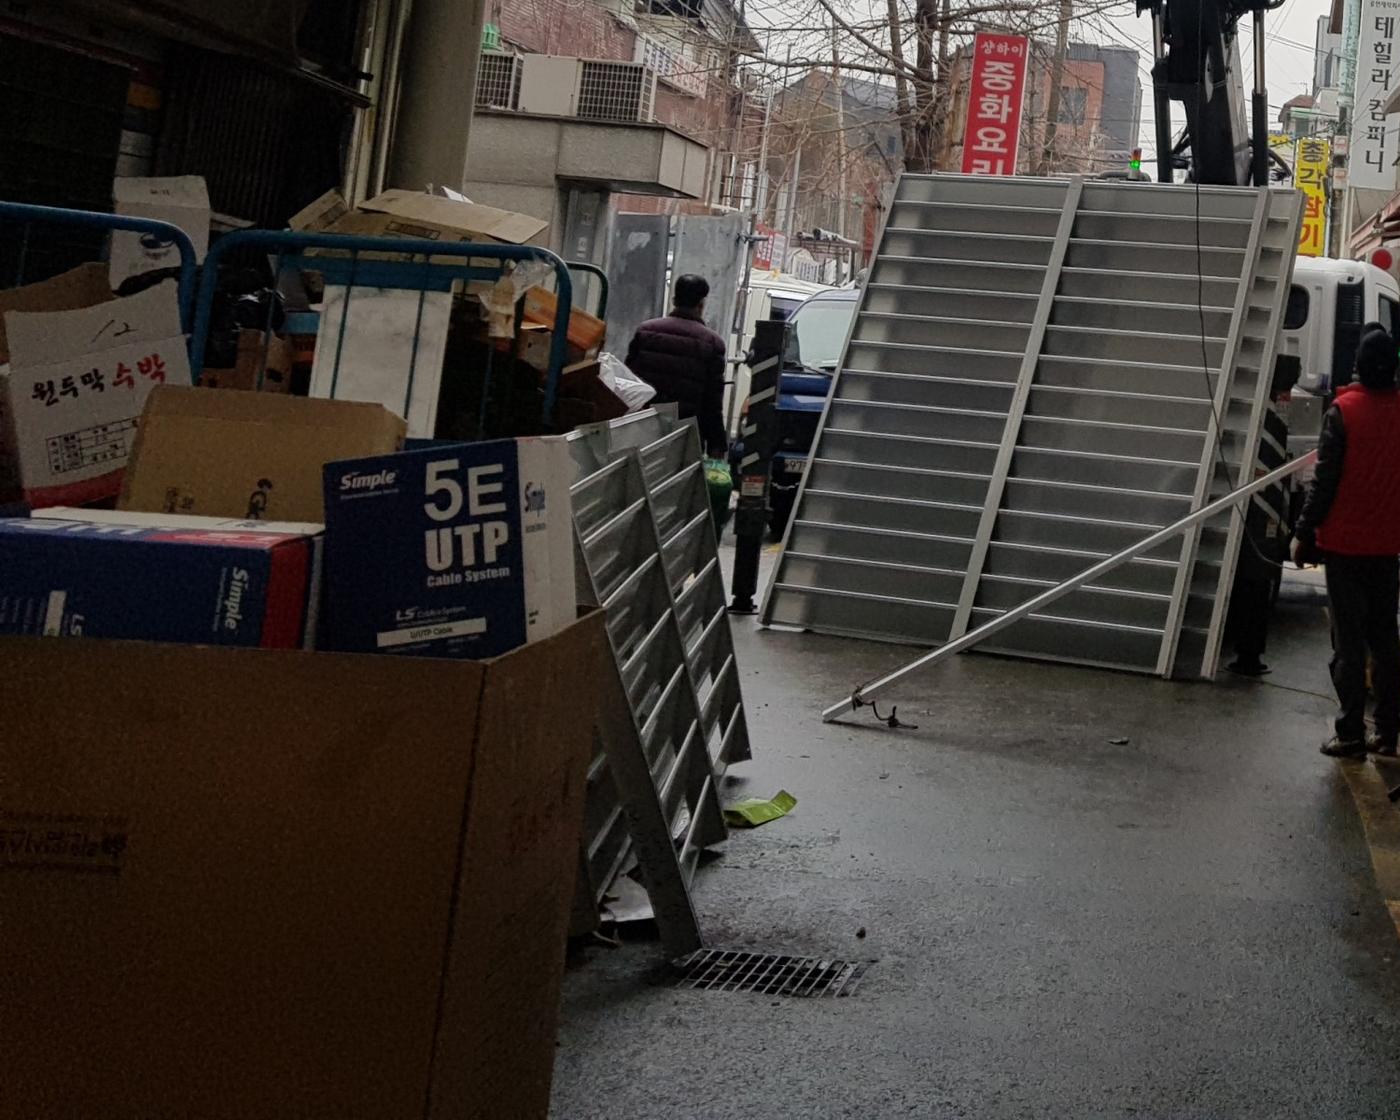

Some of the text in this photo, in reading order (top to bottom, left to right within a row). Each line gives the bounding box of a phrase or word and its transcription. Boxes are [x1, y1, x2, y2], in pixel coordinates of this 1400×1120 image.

[981, 40, 1024, 58] 상하이
[1371, 16, 1395, 91] 테힐라
[971, 61, 1016, 176] 중화요리
[32, 353, 166, 406] 원두막 수박
[339, 469, 397, 491] Simple
[424, 458, 508, 522] 5E
[424, 520, 509, 572] UTP
[224, 566, 248, 631] Simple
[427, 566, 510, 588] Cable System
